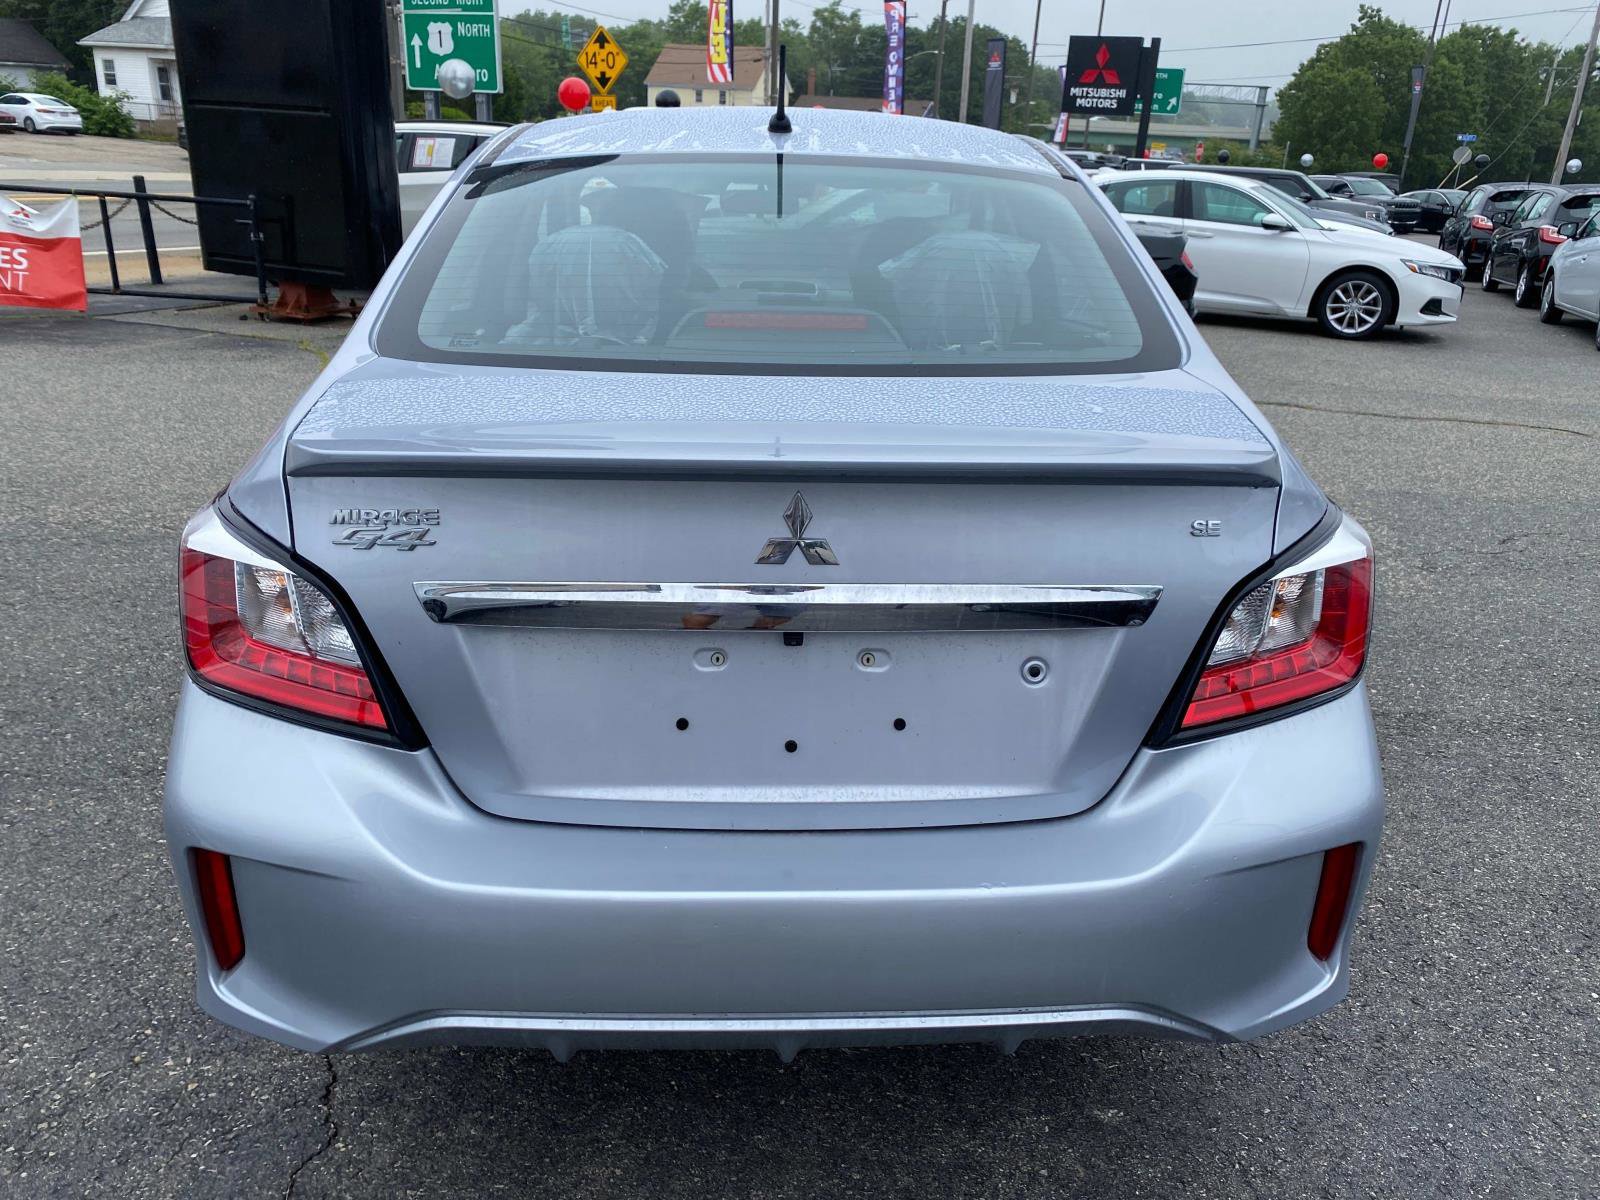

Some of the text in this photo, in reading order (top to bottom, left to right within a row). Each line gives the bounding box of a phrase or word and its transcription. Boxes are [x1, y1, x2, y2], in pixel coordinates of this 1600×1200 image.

[457, 22, 491, 37] NORTH
[1069, 87, 1127, 98] MITSUBISHI
[1076, 98, 1118, 109] MOTORS
[329, 508, 440, 527] MIRAGE
[1190, 519, 1222, 537] SE
[332, 526, 437, 551] G4
